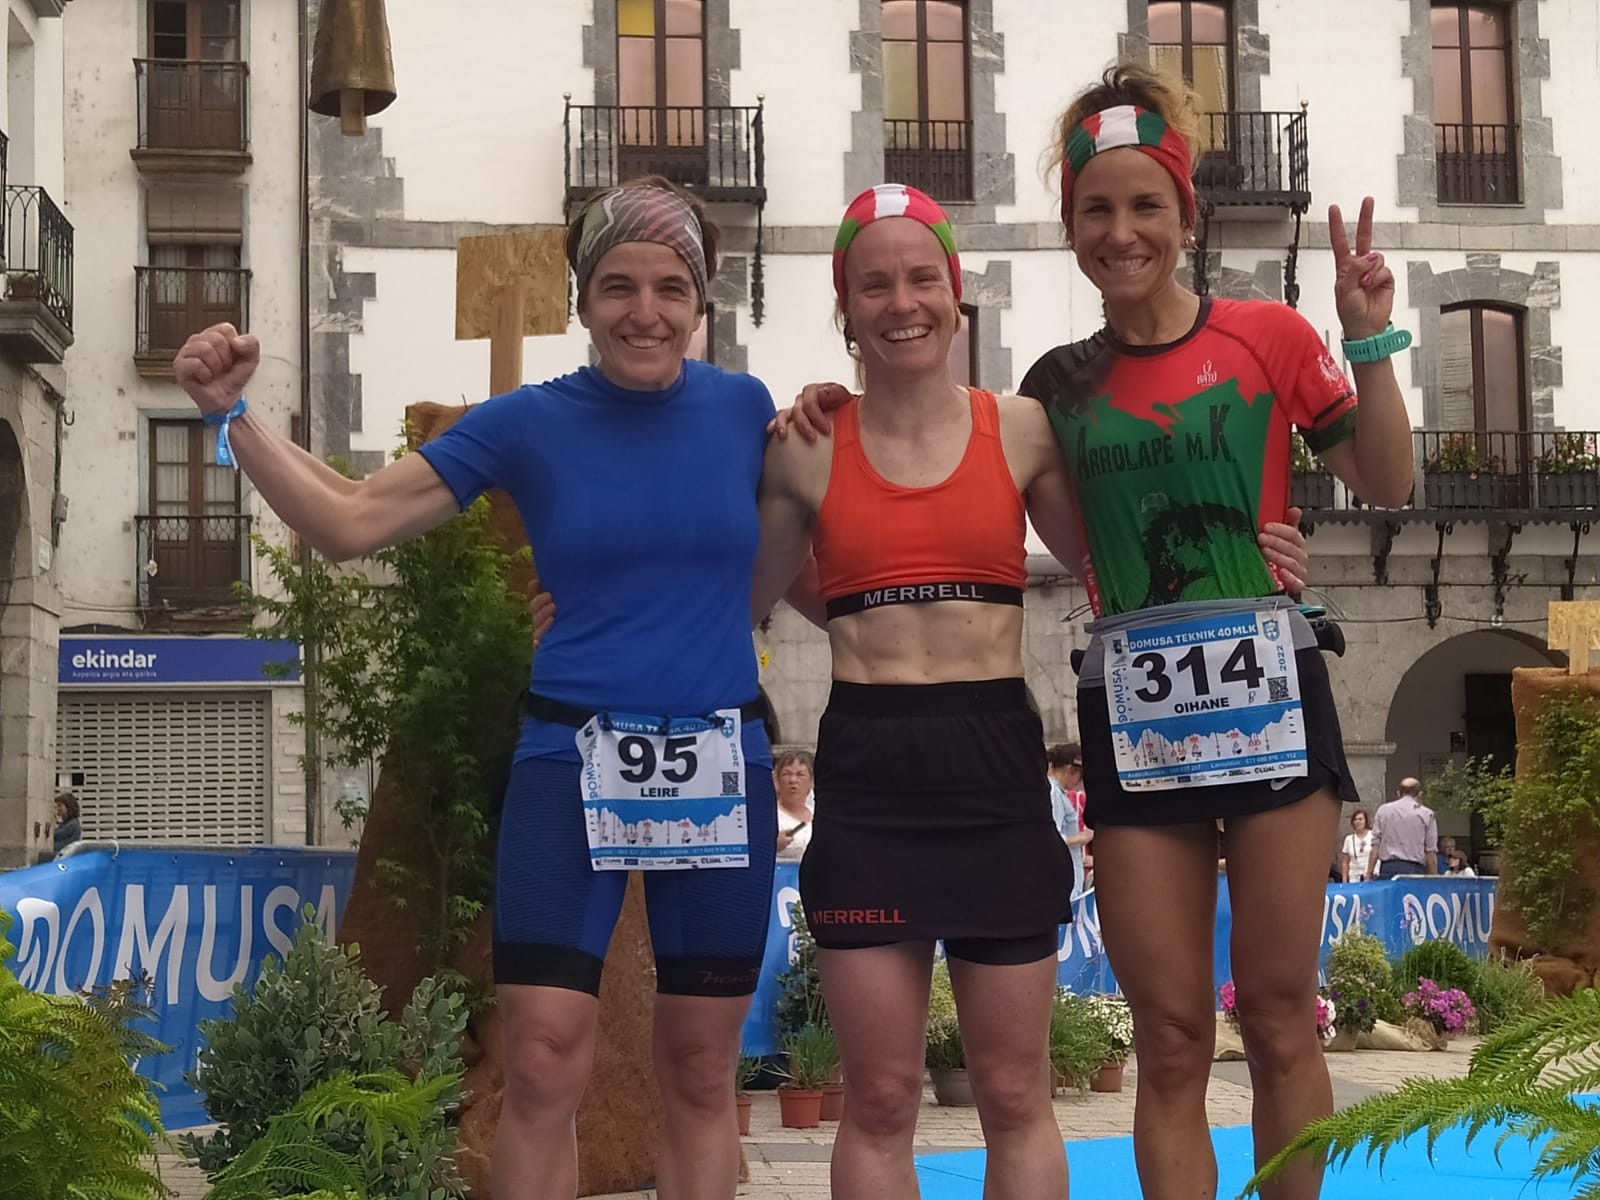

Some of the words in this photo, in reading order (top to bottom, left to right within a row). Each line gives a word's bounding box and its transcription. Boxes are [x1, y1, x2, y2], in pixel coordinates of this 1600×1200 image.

[864, 585, 984, 607] MERRELL
[1130, 635, 1173, 650] DOMUSA
[1175, 629, 1216, 643] TEKNIK
[72, 648, 157, 669] ekindar
[1277, 644, 1287, 672] 2022
[1131, 637, 1265, 704] 314
[1174, 697, 1230, 714] OIHANE
[617, 735, 698, 784] 95
[640, 787, 679, 798] LEIRE
[812, 909, 907, 924] MERRELL
